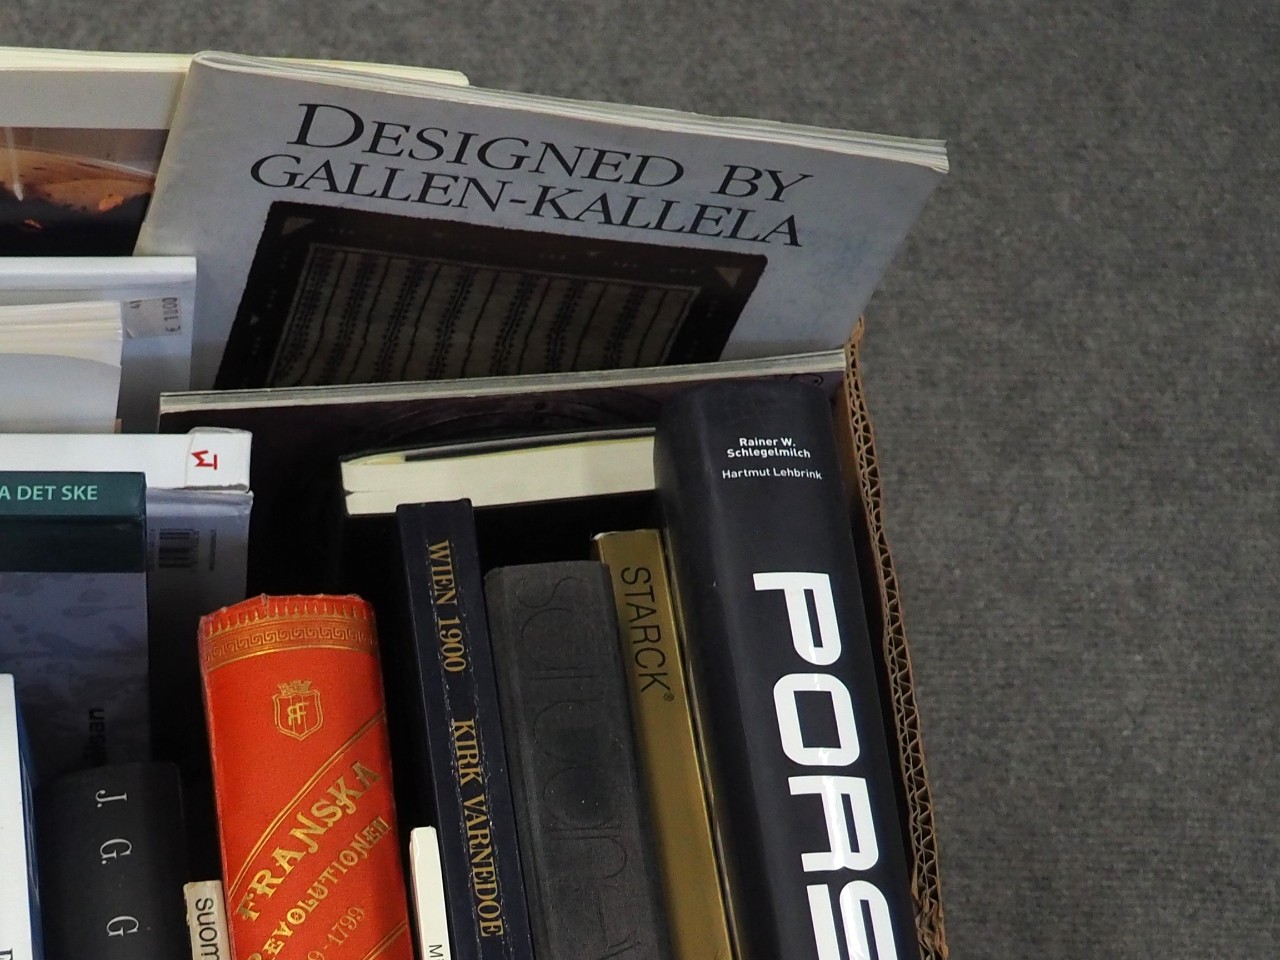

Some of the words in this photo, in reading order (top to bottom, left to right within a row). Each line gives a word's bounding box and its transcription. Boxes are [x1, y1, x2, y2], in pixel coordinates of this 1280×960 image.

[287, 103, 684, 187] DESIGNED
[710, 165, 813, 202] BY
[250, 154, 803, 247] GALLEN-KALLELA
[722, 468, 771, 479] Hartmut
[773, 467, 823, 480] Lehbrink
[727, 448, 811, 458] Schlegelmilch
[739, 437, 779, 446] Rainer
[781, 438, 796, 446] W.
[16, 485, 57, 500] DET
[61, 485, 98, 500] SKE
[428, 540, 456, 607] WIEN
[438, 617, 467, 673] 1900
[452, 719, 483, 787] KIRK
[236, 761, 381, 922] FRANSKA
[461, 793, 504, 938] VARNEDOE
